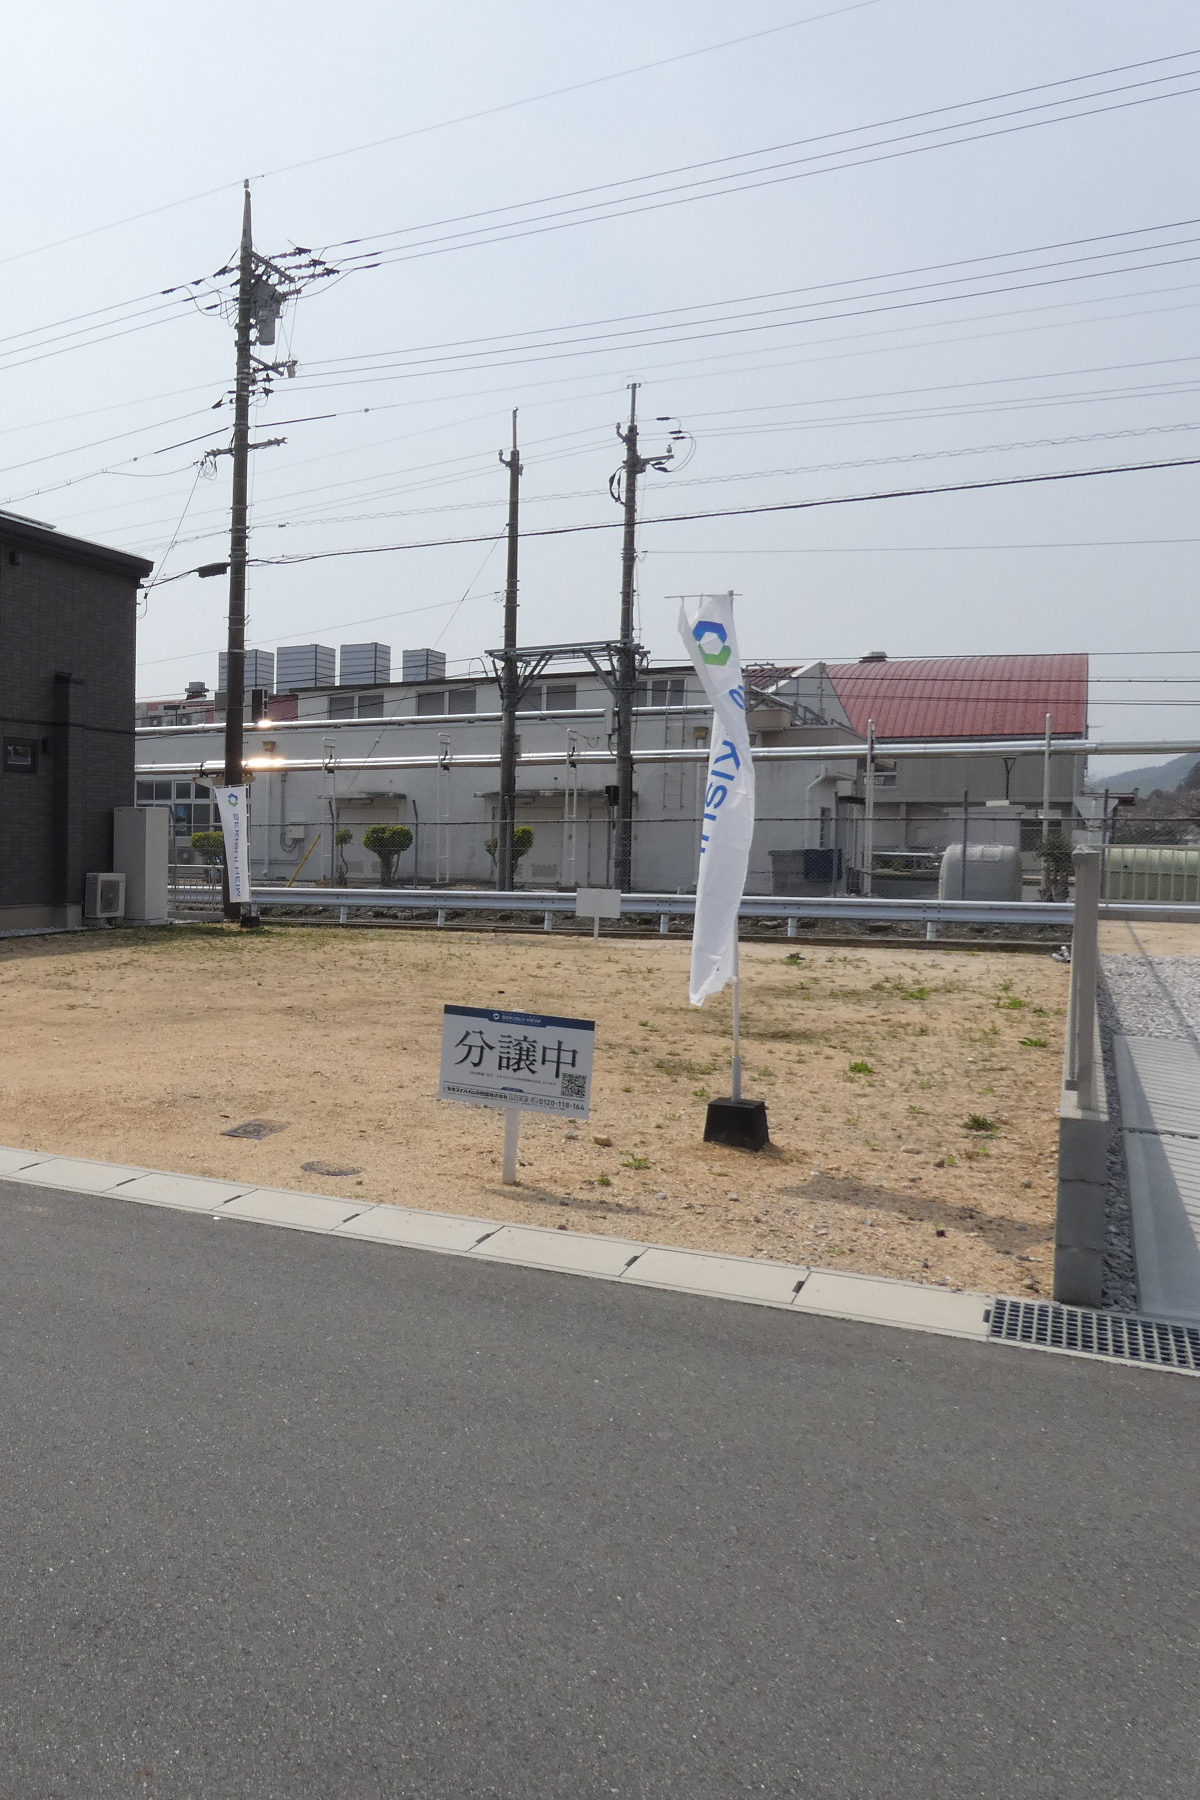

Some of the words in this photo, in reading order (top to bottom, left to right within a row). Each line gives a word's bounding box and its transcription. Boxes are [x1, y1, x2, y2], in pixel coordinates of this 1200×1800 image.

[454, 1030, 578, 1078] 分譲中
[538, 1098, 585, 1111] 0120-118-164
